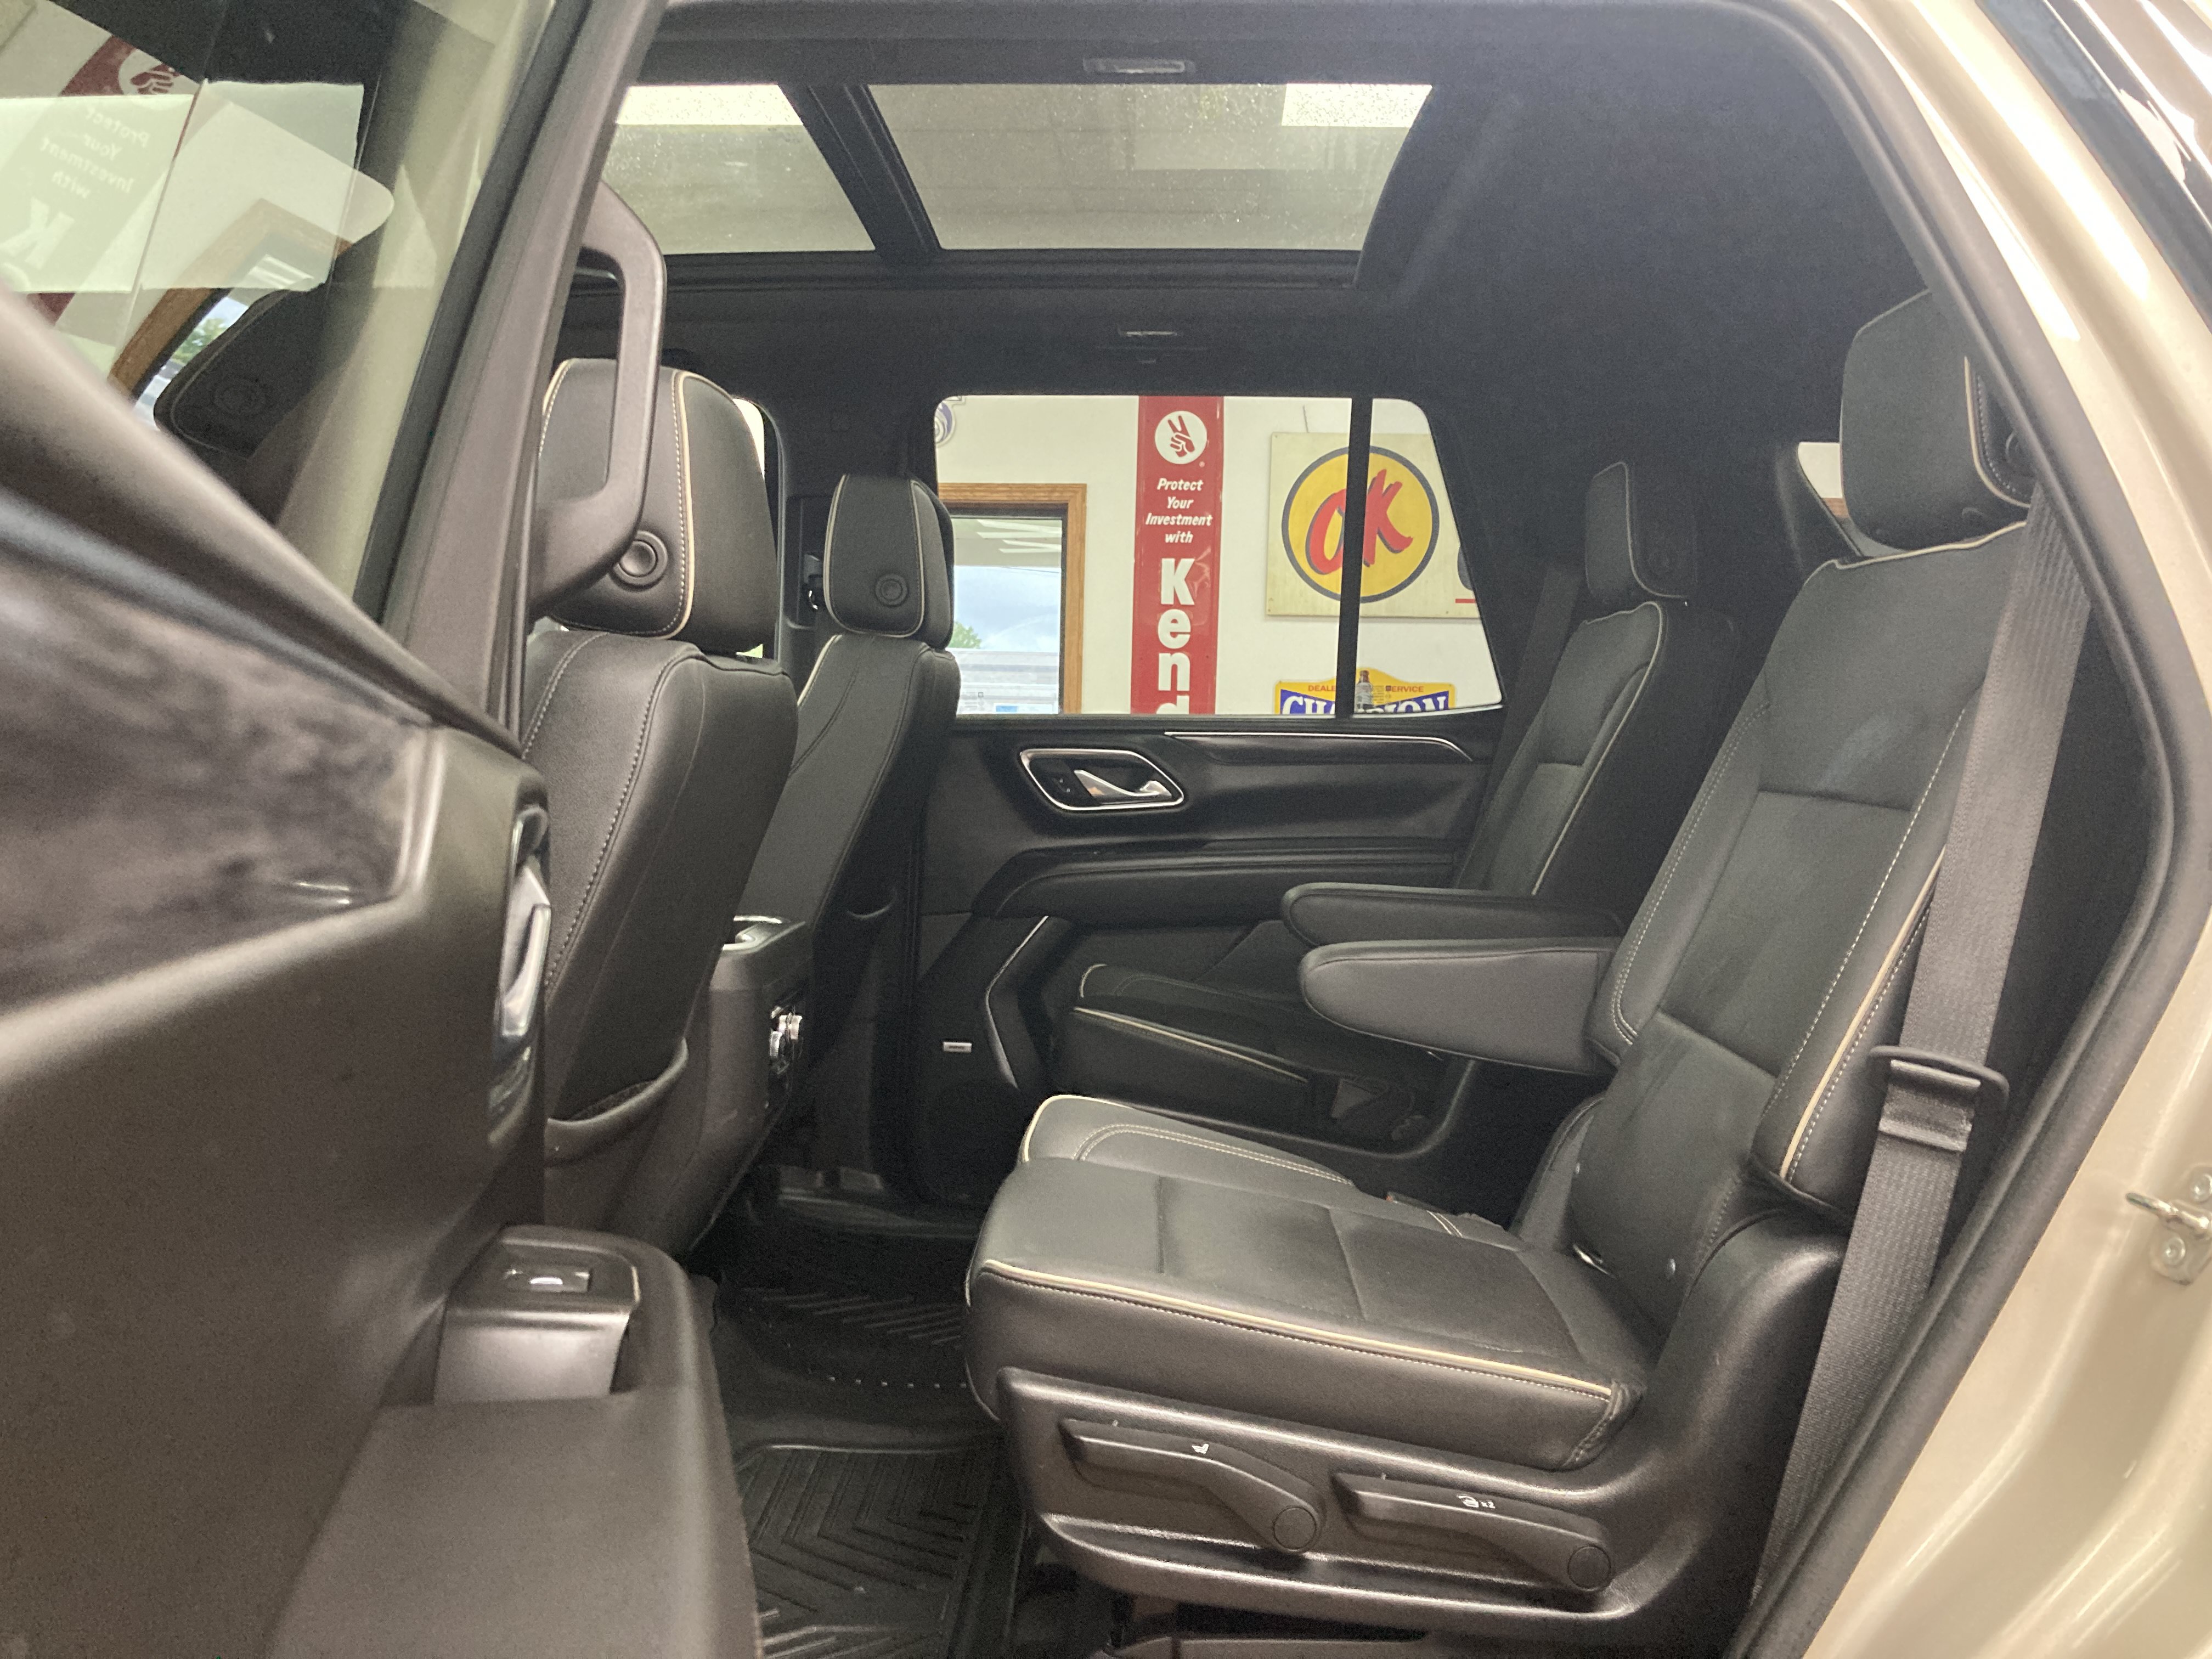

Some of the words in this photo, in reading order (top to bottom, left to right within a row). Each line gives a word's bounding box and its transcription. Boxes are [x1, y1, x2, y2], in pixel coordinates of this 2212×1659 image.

[1156, 477, 1204, 491] Protect
[1167, 496, 1194, 509] Your
[1145, 512, 1213, 526] Investment
[1305, 469, 1413, 575] OK
[1165, 531, 1194, 543] with
